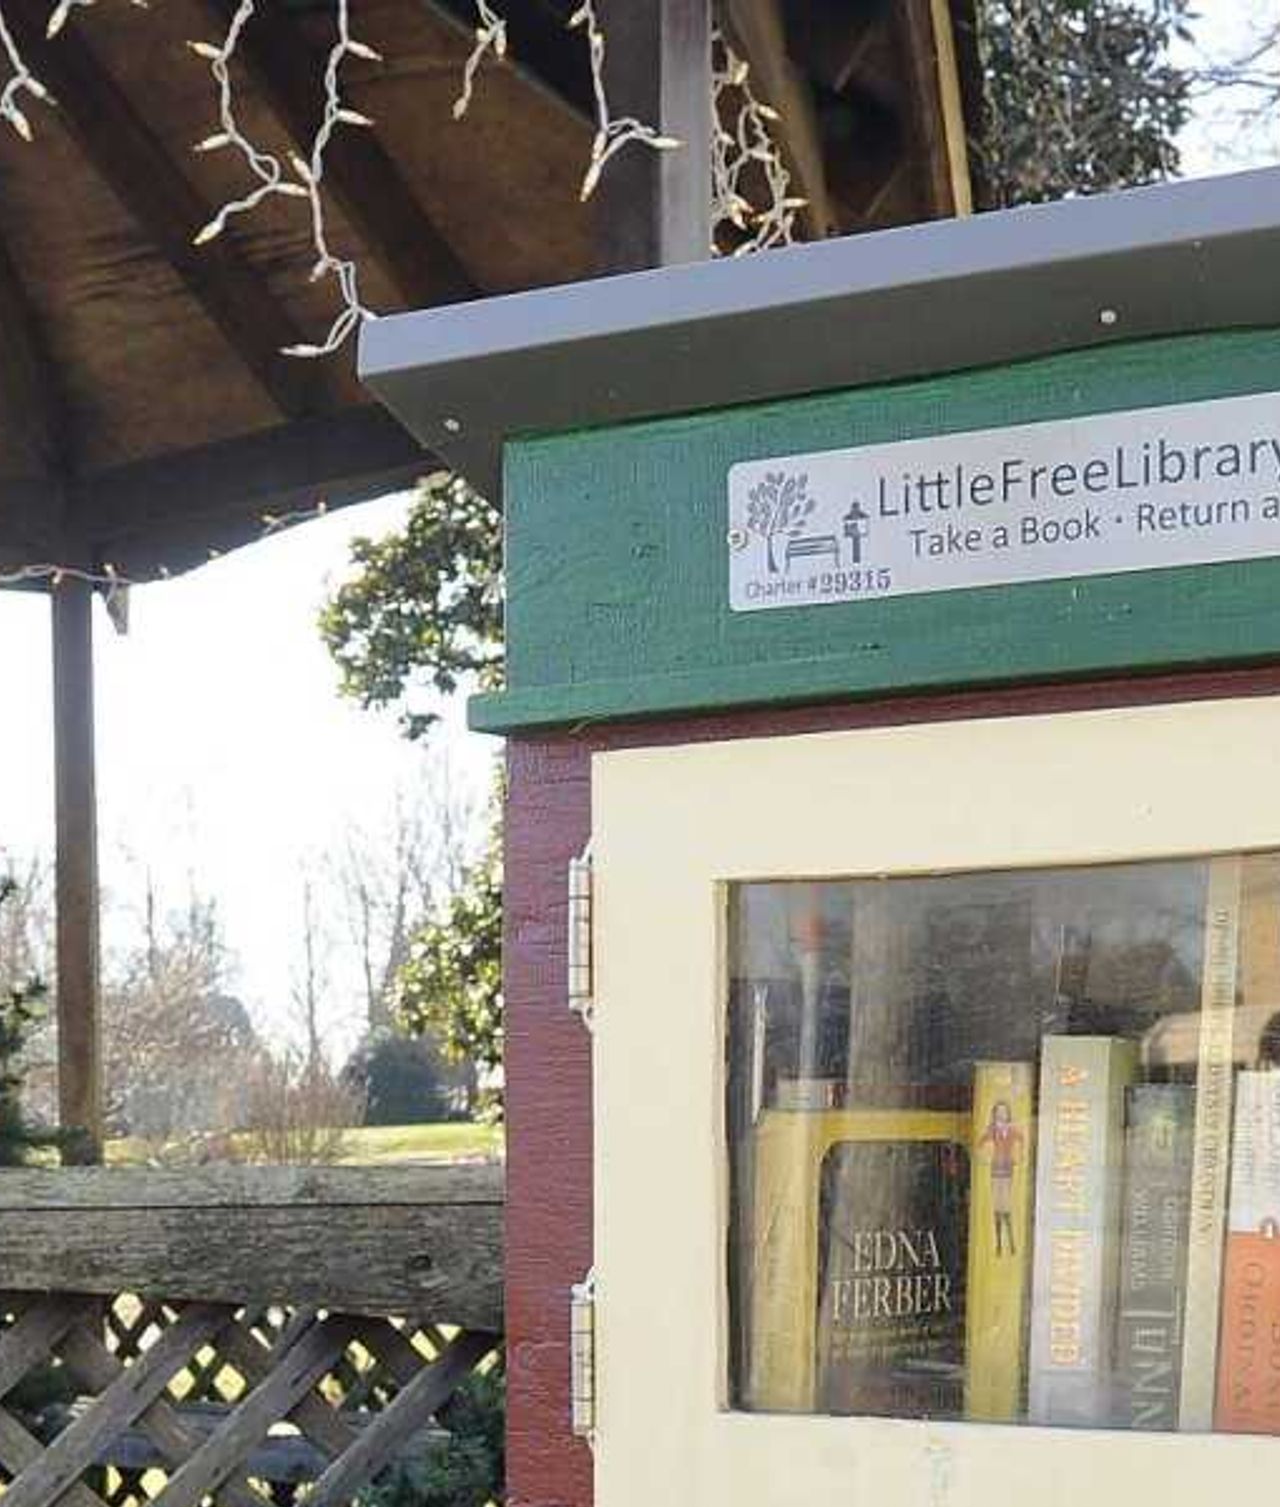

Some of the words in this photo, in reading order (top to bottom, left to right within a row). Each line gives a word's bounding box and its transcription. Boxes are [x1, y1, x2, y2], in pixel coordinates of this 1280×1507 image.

[909, 524, 982, 558] Take
[992, 525, 1010, 549] a
[1020, 508, 1100, 546] Book
[1136, 490, 1250, 533] Return
[1261, 495, 1280, 519] a
[746, 578, 802, 600] Charter
[852, 1229, 941, 1273] EDNA
[830, 1273, 953, 1322] FERBER
